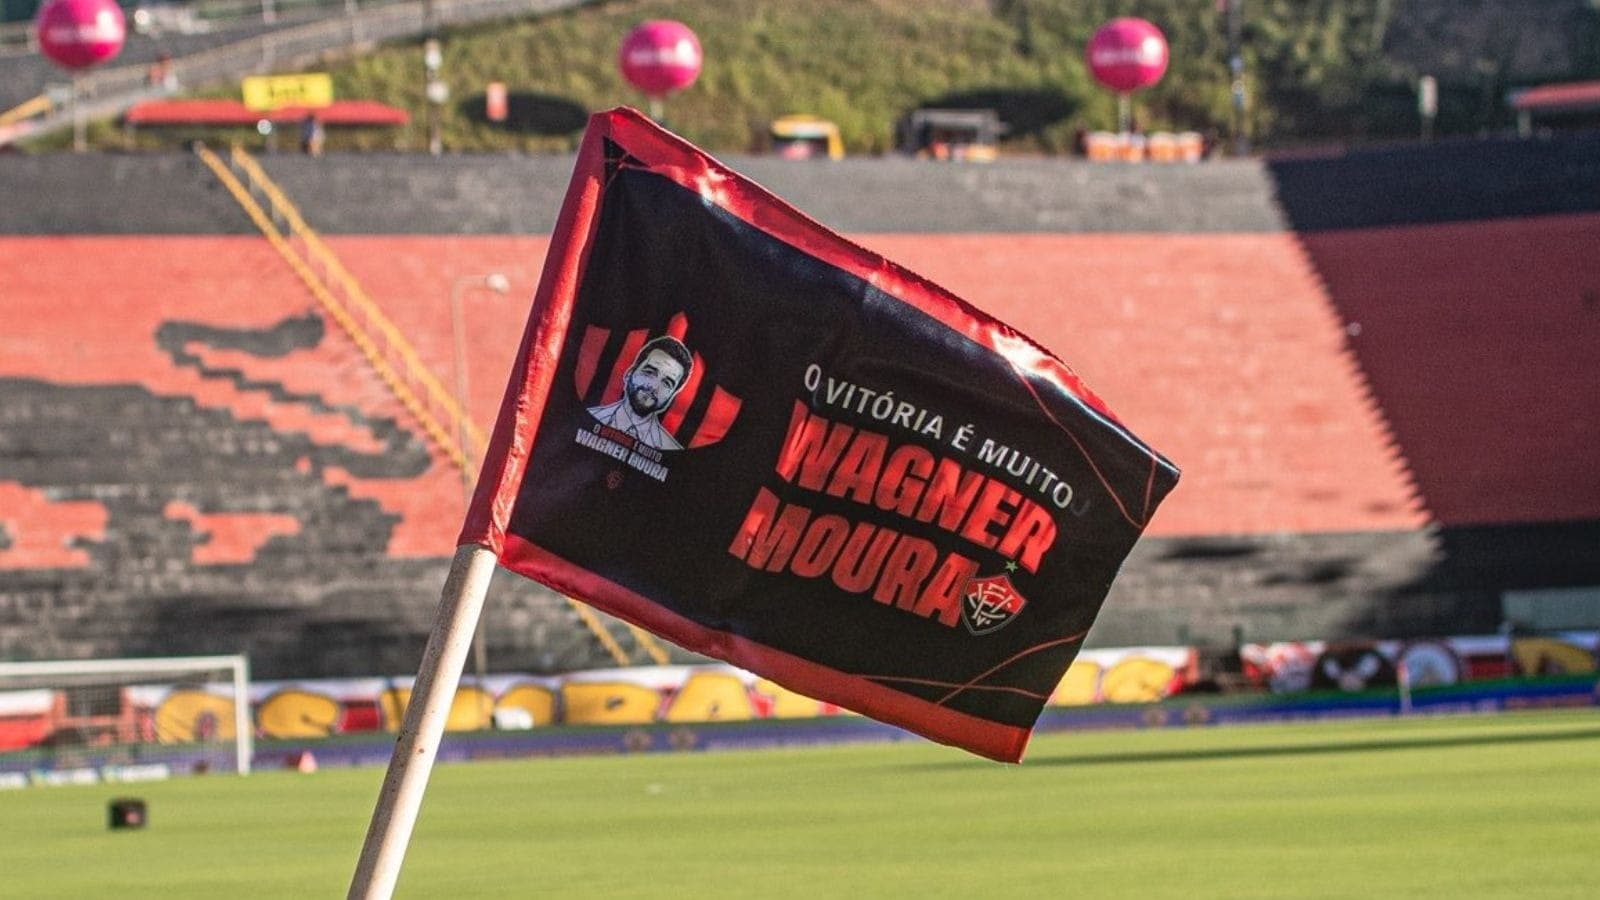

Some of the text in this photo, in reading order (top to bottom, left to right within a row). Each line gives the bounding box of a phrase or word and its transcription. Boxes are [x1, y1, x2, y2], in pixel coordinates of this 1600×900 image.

[575, 427, 630, 462] WAGNER
[627, 450, 669, 482] MOURA
[775, 398, 1057, 574] WAGNER
[803, 363, 1074, 509] O VITÓRIA É MUITO
[728, 485, 979, 628] MOURA
